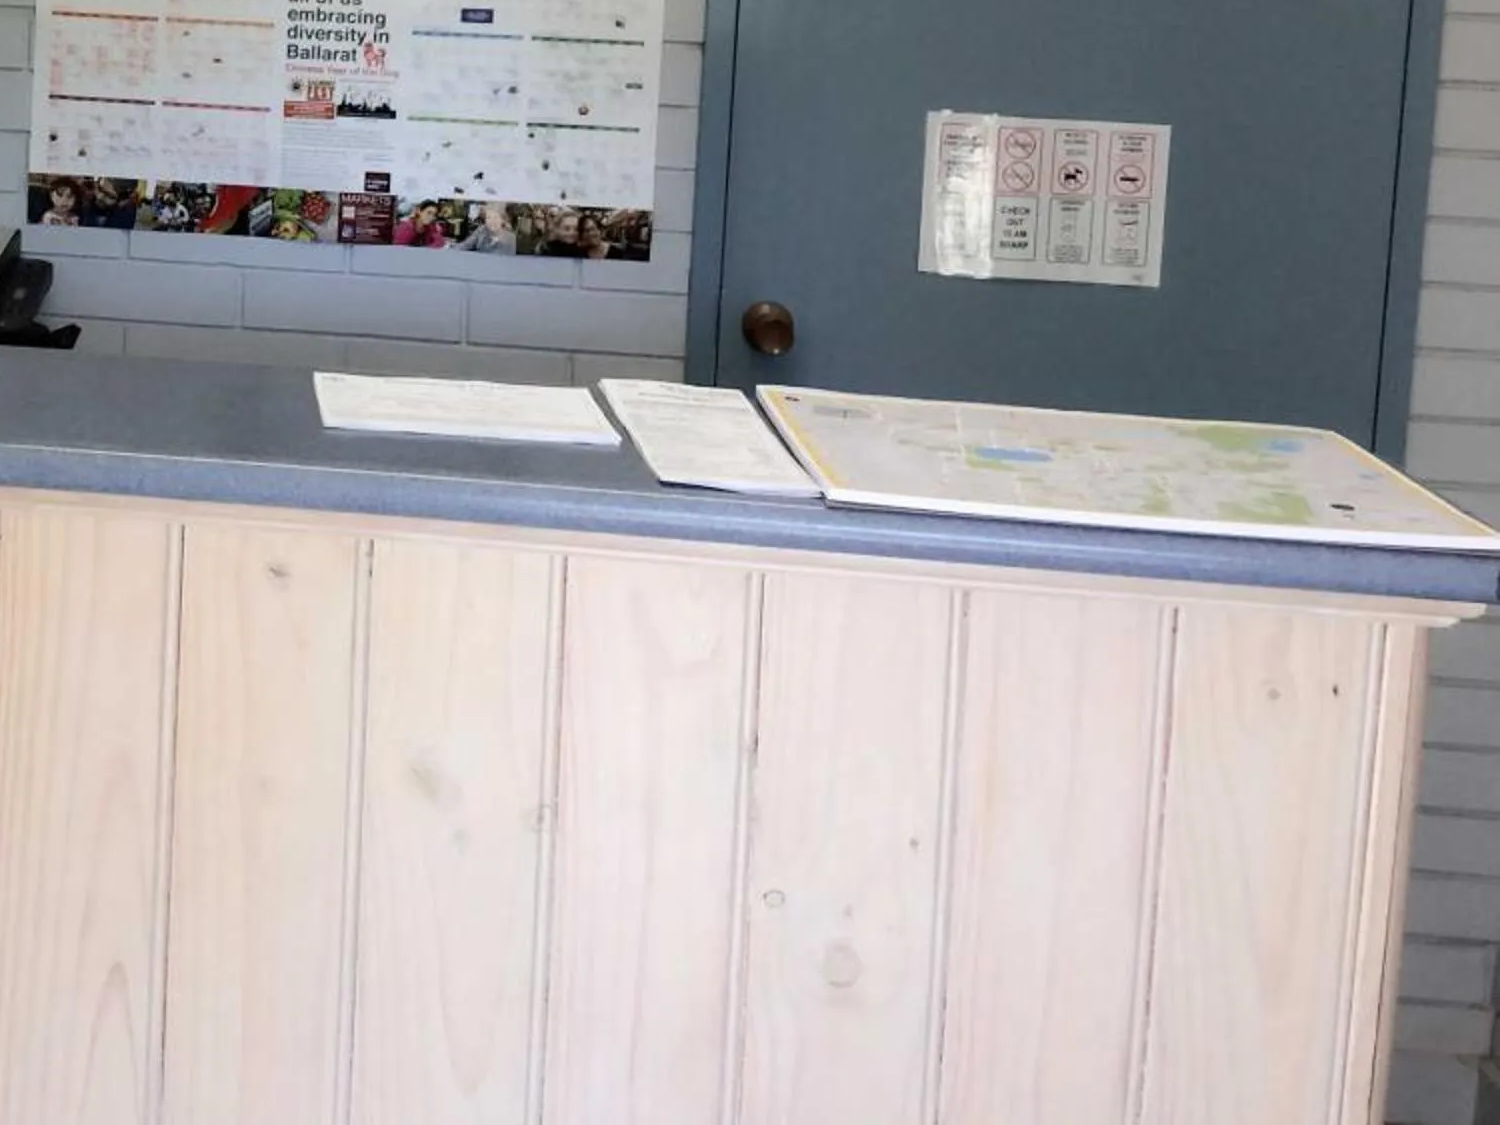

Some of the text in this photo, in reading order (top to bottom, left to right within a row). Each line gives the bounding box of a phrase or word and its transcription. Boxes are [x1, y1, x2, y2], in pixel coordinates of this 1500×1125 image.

[287, 8, 387, 29] embracing
[287, 24, 390, 46] diversity in
[287, 44, 357, 62] Ballarat
